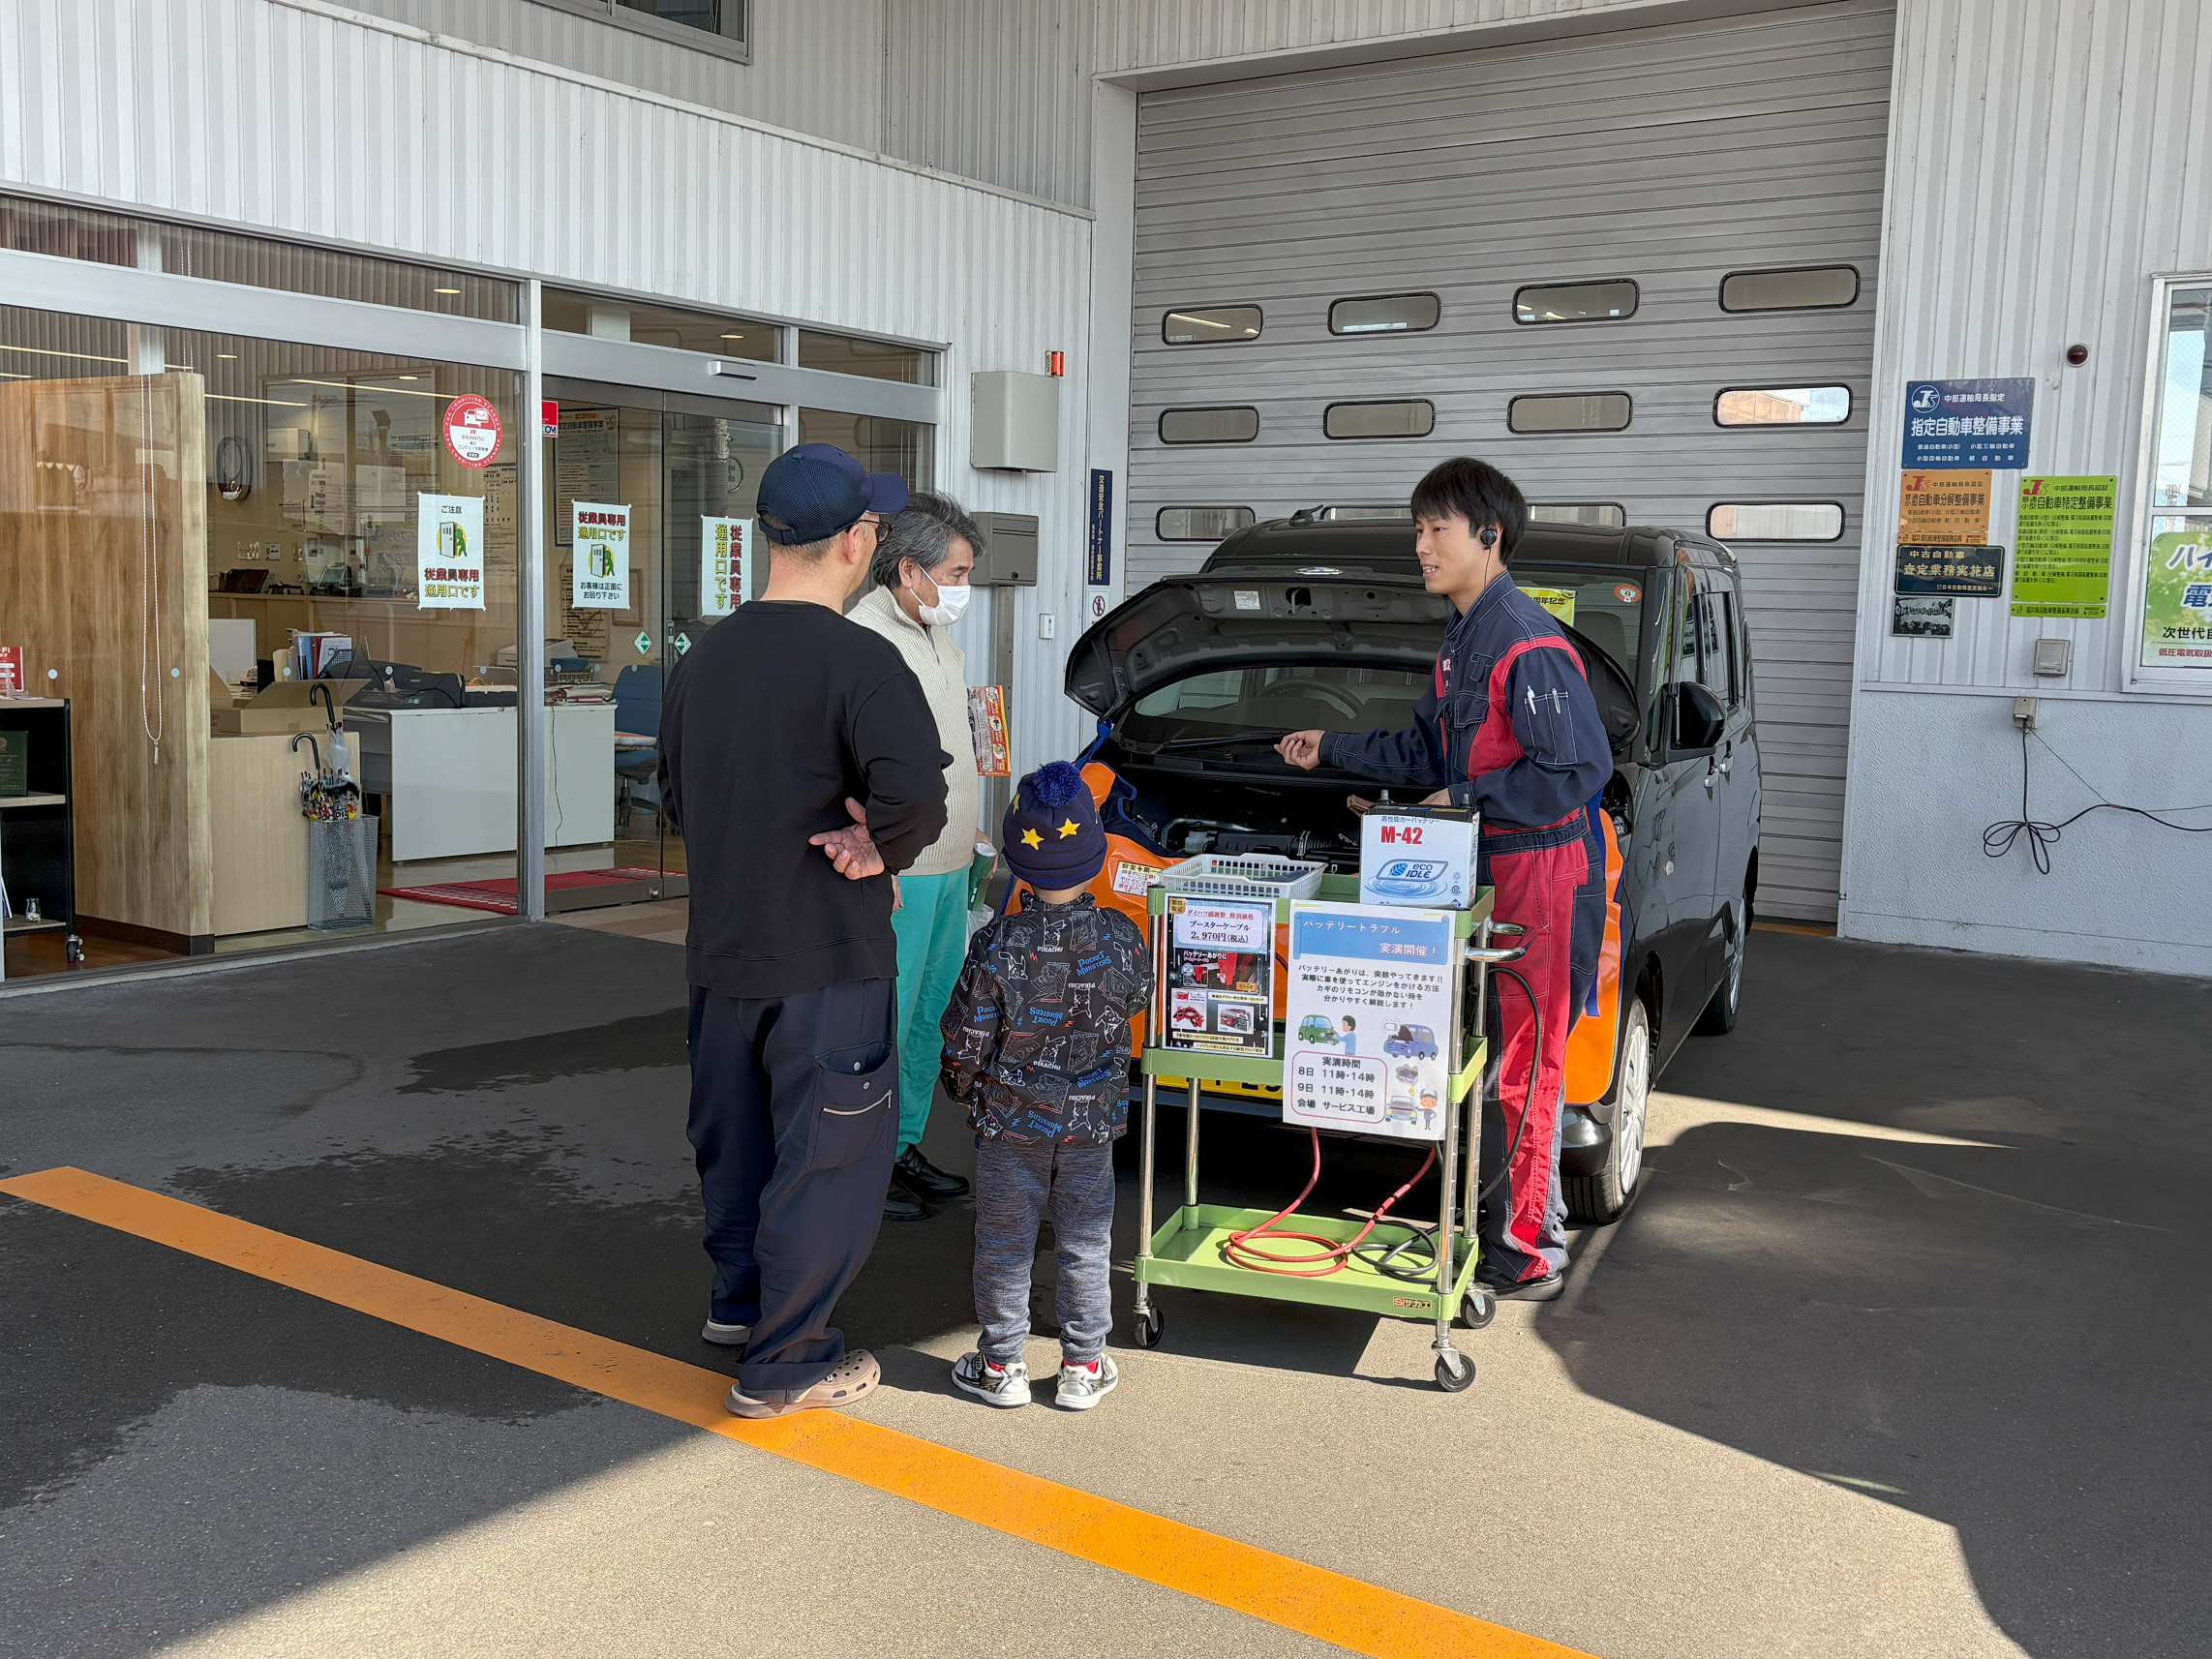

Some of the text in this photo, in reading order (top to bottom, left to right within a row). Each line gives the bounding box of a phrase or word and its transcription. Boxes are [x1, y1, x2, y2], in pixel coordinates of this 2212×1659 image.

[1911, 416, 2024, 437] 指定自動車整備事業
[2037, 497, 2113, 509] 自動車特定整備事業
[578, 511, 625, 527] 従業員専用
[578, 527, 625, 541] 通用口です
[1910, 550, 1964, 558] 中古自動車
[715, 524, 727, 609] 通用口です
[730, 525, 742, 609] 従業員専用
[1903, 563, 1995, 578] 査定業務実施店
[424, 567, 479, 582] 従業員専用
[425, 584, 479, 598] 通用口です
[1381, 826, 1423, 845] M-42
[1406, 870, 1432, 879] IDLE
[1190, 920, 1251, 931] ブースターケーブル
[1303, 920, 1401, 934] バッテリートラブル
[1317, 984, 1423, 1001] カギのリモコンが効かない時を
[962, 1026, 990, 1037] PIKACHU
[1033, 1061, 1062, 1071] PIKACHU
[1322, 1056, 1361, 1069] 実演時間
[1298, 1067, 1315, 1076] 8日
[1297, 1083, 1314, 1093] 9日
[1297, 1099, 1376, 1116] 会場 サービス工場
